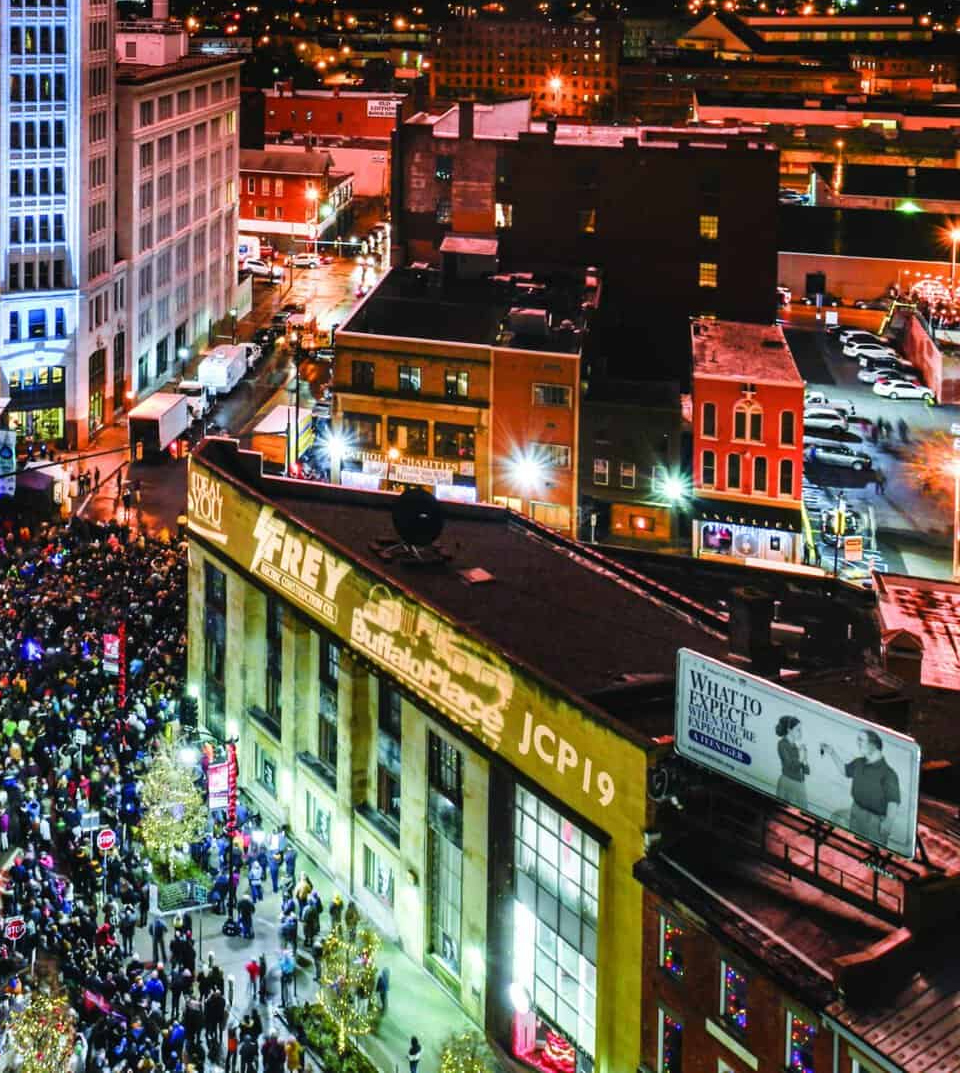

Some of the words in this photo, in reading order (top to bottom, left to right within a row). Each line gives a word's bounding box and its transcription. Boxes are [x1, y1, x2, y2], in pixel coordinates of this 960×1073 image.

[399, 457, 459, 472] CHARITIES
[192, 486, 223, 528] YOU
[254, 509, 352, 601] FREY
[689, 689, 749, 727] EXPECT
[690, 669, 738, 705] WHAT
[740, 693, 762, 716] TO
[688, 704, 719, 726] WHEN
[719, 716, 757, 744] YOU'RE
[688, 715, 744, 748] EXPECTING
[700, 735, 744, 760] TEENAGER
